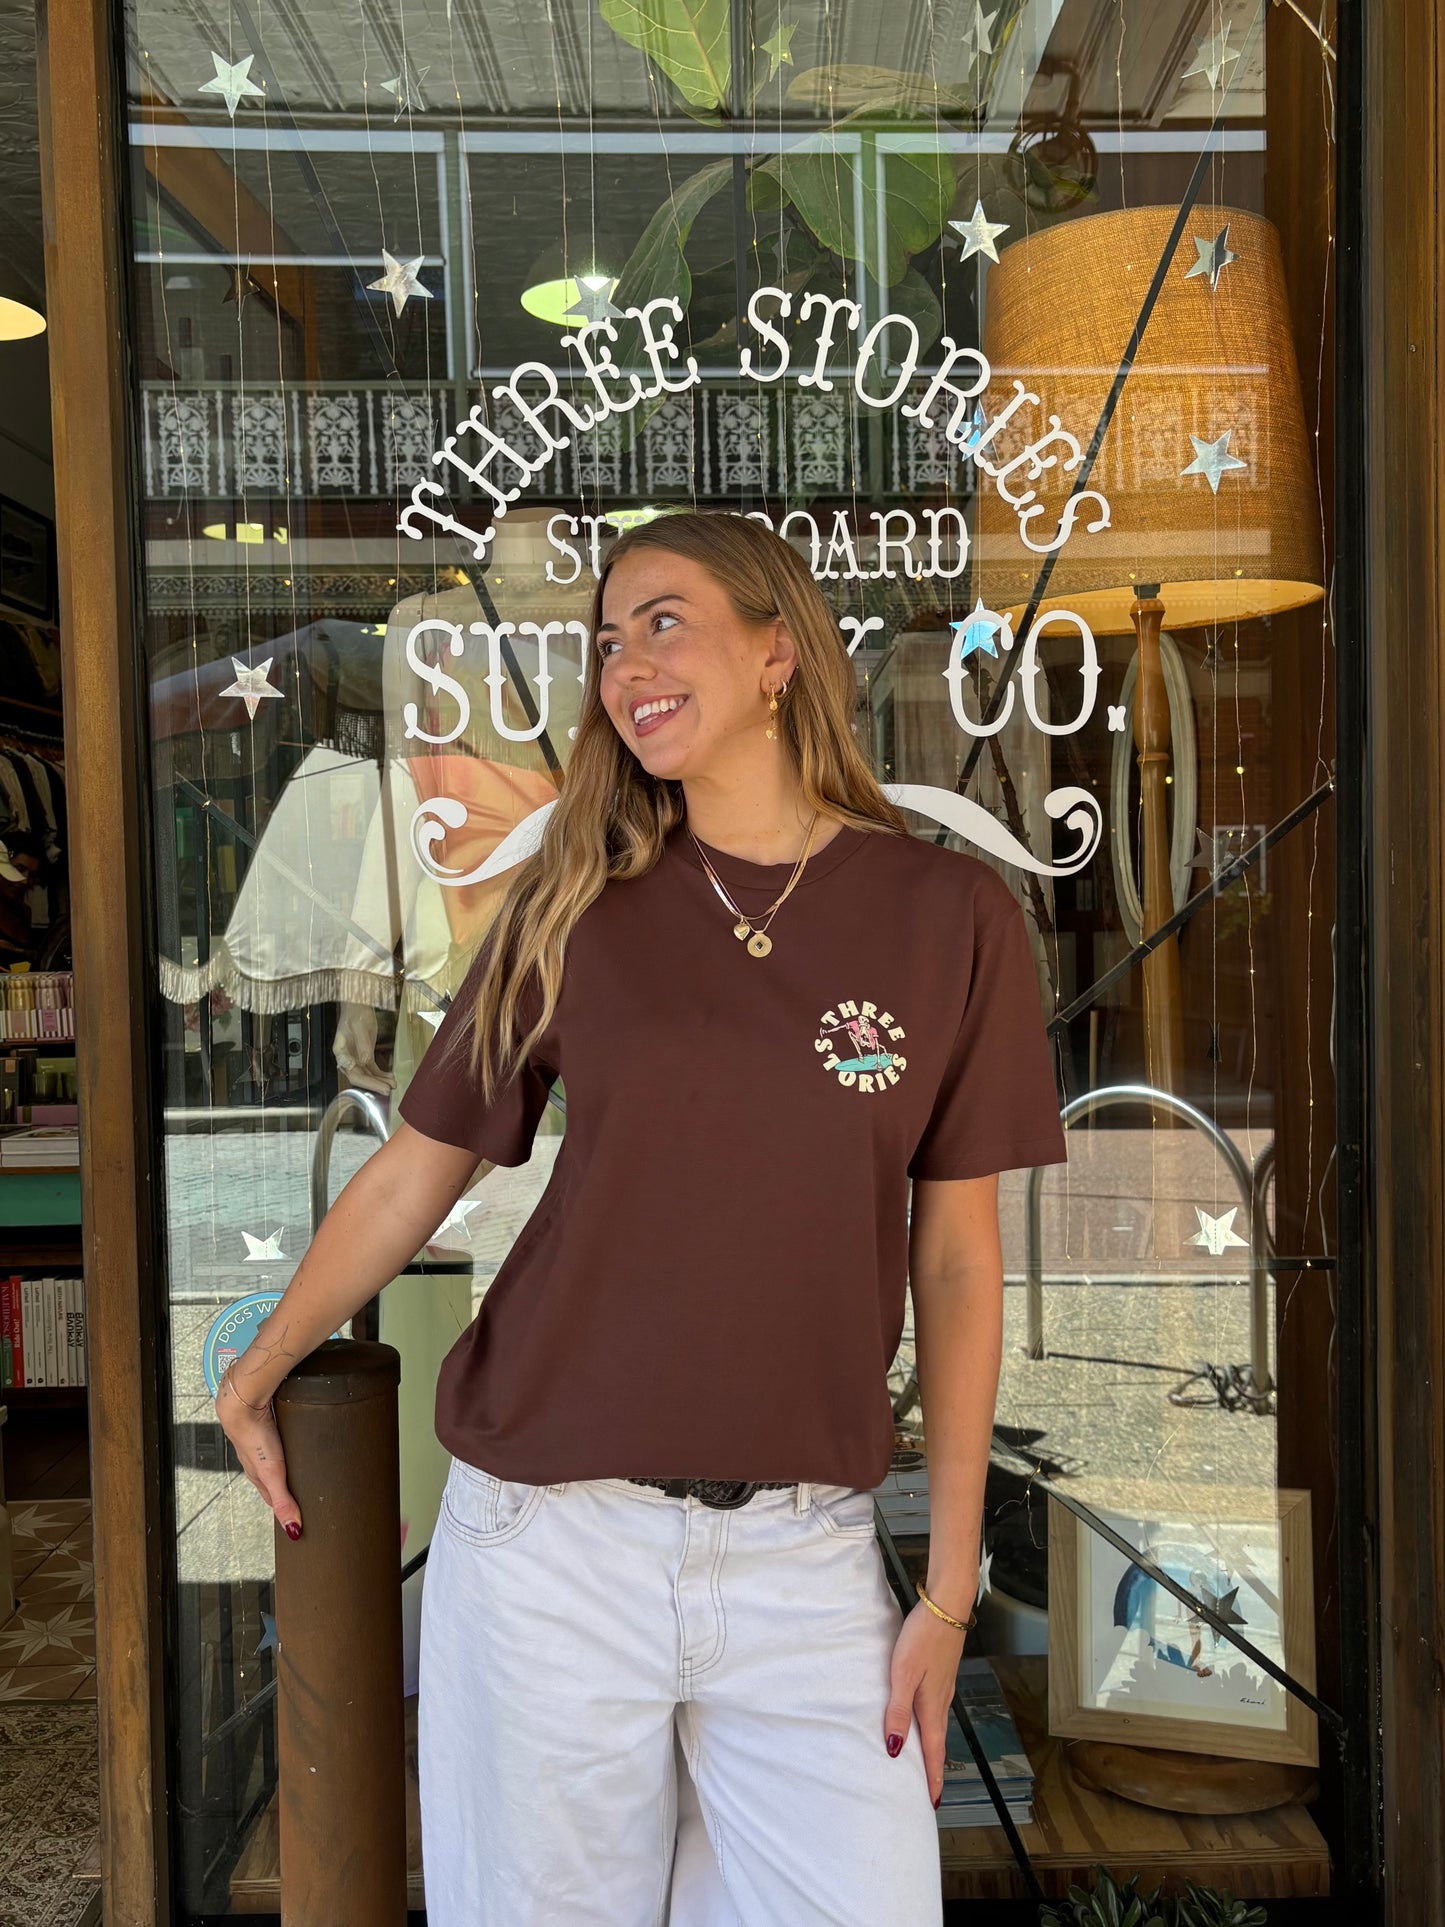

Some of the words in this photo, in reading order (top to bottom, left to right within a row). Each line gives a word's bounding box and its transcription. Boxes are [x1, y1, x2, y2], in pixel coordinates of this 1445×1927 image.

[396, 294, 702, 561] THREE
[739, 286, 1112, 554] STORIES
[545, 506, 972, 585] SUOARD
[942, 608, 1127, 738] CO.
[820, 1000, 906, 1042] THREE
[814, 1038, 907, 1093] STORIES
[218, 1308, 253, 1343] DOGS
